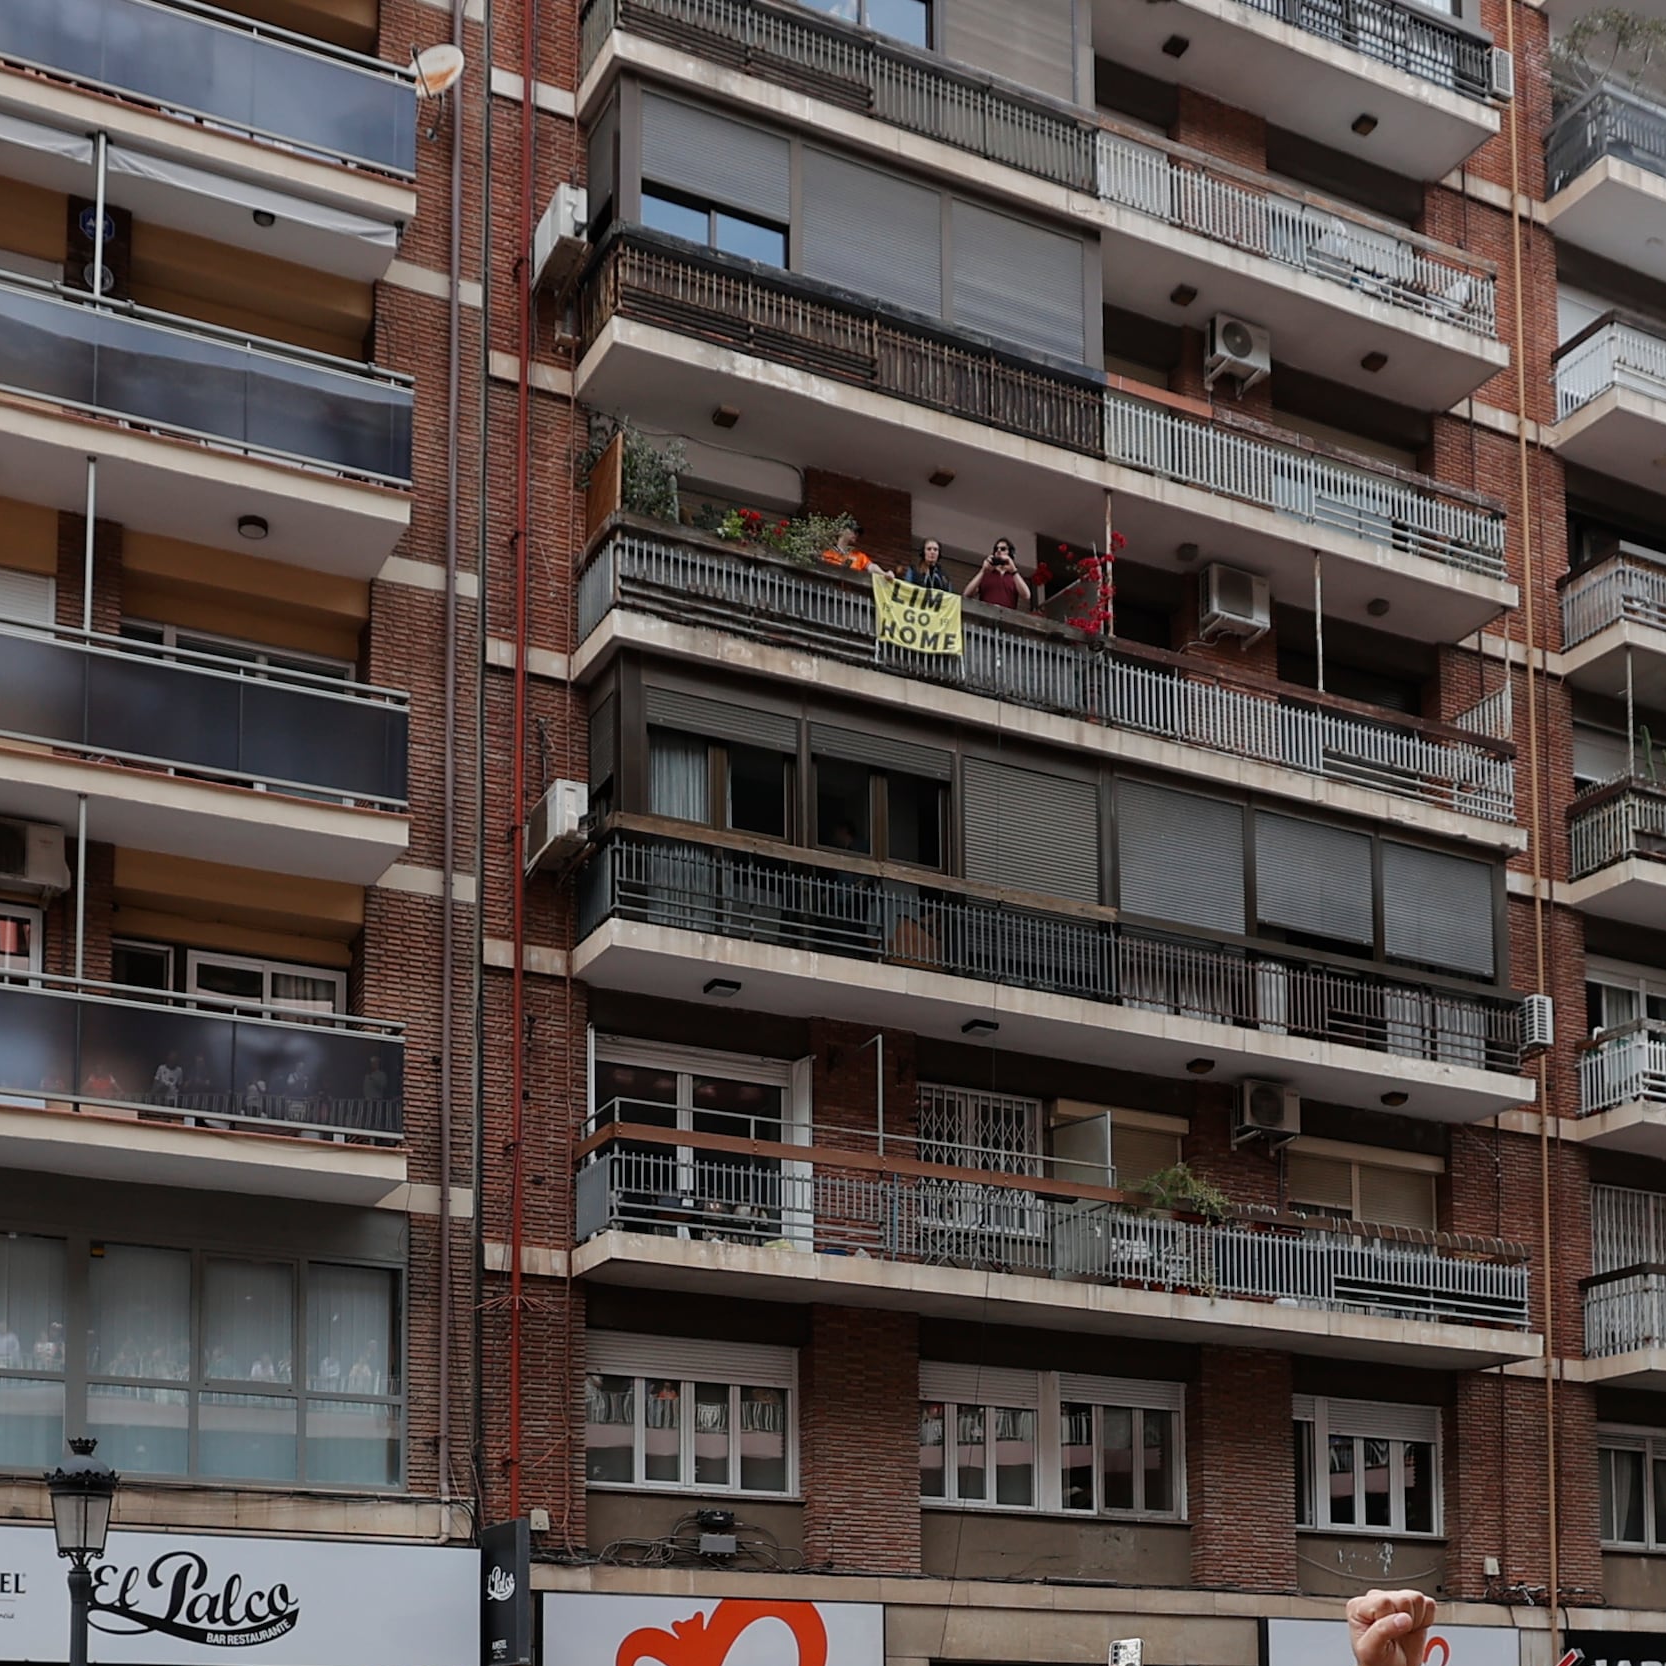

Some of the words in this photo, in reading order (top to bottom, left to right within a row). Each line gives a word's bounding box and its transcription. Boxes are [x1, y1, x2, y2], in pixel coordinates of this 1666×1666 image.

[892, 580, 944, 612] LIM
[881, 617, 957, 651] HOME
[903, 609, 930, 627] GO
[89, 1564, 139, 1610] El
[147, 1551, 299, 1628] Palco
[206, 1630, 226, 1645] BAR
[227, 1618, 292, 1645] RESTAURANTE
